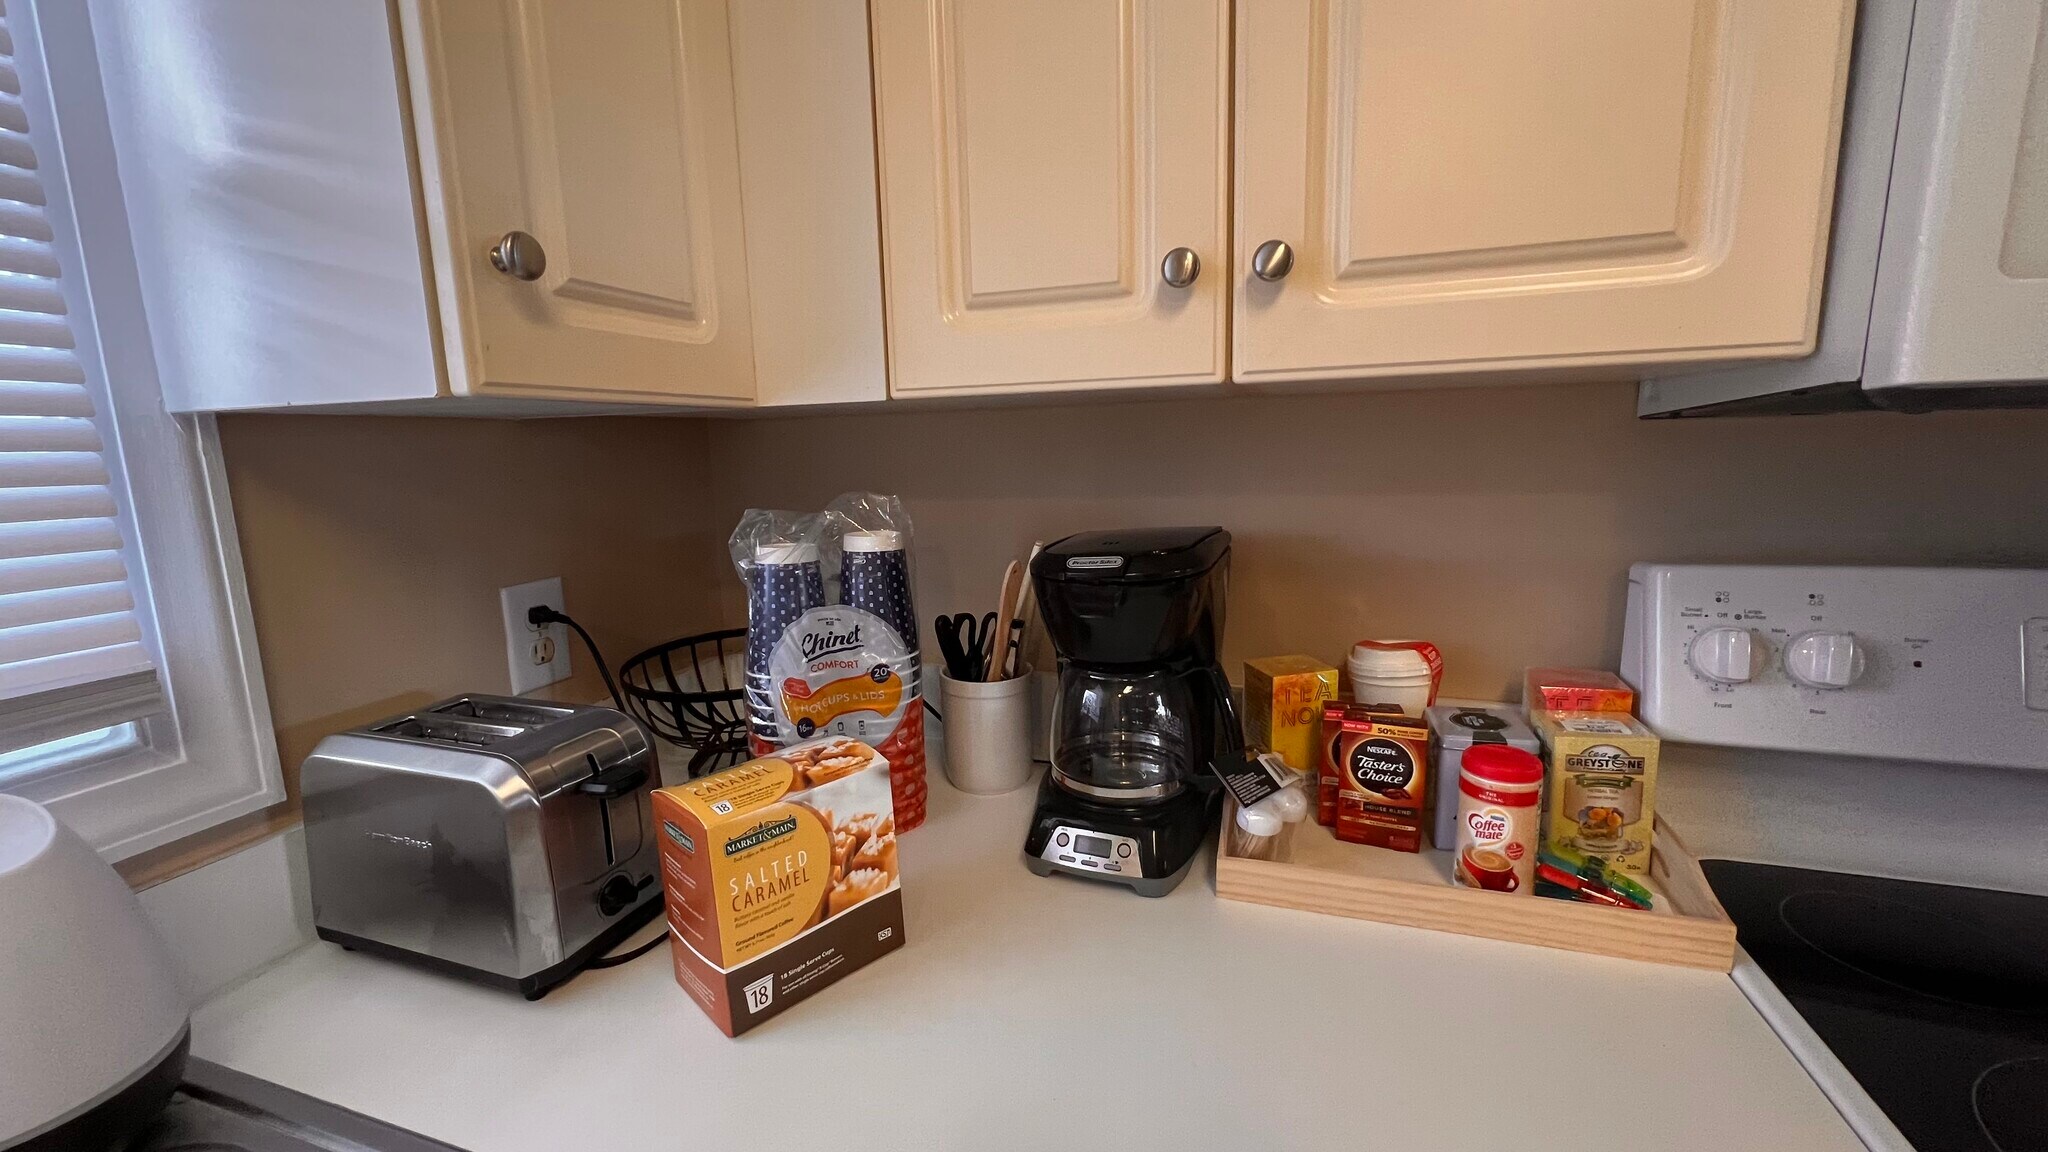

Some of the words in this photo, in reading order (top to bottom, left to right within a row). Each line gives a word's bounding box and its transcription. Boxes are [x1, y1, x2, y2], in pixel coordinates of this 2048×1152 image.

[802, 624, 862, 661] Chinet
[810, 659, 859, 673] COMFORT
[873, 667, 888, 678] 20
[859, 690, 886, 701] LIDS
[1714, 701, 1733, 709] Front
[1377, 727, 1397, 735] 50%
[1357, 755, 1406, 773] Taster's
[1567, 757, 1643, 769] GREYSTONE
[693, 768, 775, 797] CARAMEL
[1357, 768, 1403, 784] Choice
[715, 803, 731, 814] 18
[1364, 804, 1387, 813] HOUSE
[1389, 808, 1412, 816] BLEND
[1468, 813, 1505, 831] Coffee
[1475, 831, 1503, 840] mate
[729, 850, 807, 896] SALTED
[732, 868, 810, 912] CARAMEL
[735, 934, 756, 947] Ground
[756, 923, 779, 938] Flavored
[778, 917, 794, 928] Coffee
[780, 971, 789, 981] 18
[788, 963, 806, 977] Single
[806, 955, 822, 967] Serve
[822, 947, 835, 959] Cups
[750, 985, 769, 1009] 18
